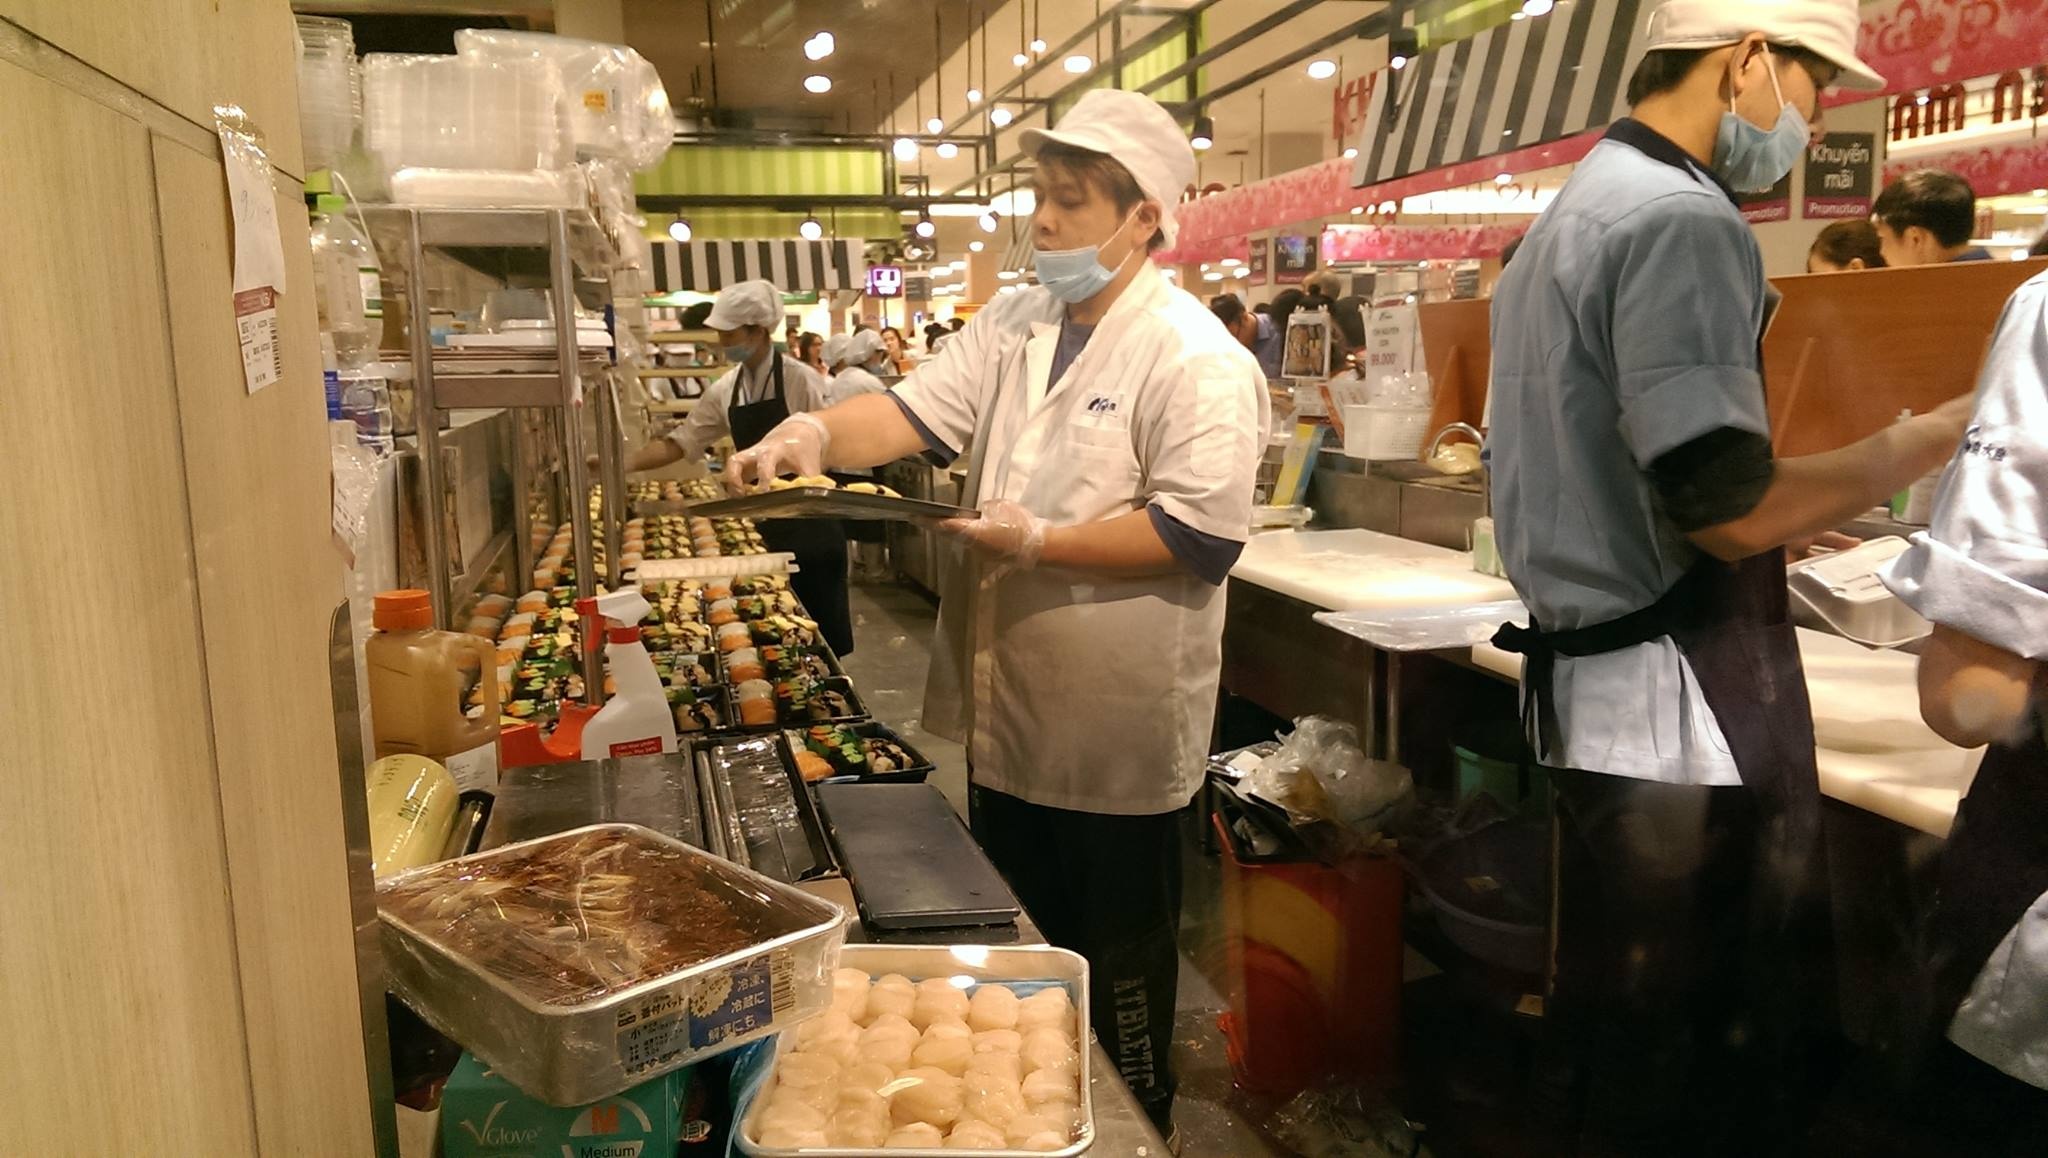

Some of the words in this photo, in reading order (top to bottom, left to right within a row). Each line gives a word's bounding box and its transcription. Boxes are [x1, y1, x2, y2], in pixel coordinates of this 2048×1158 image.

[1823, 169, 1854, 189] mãi
[1743, 205, 1785, 218] omotion
[1808, 202, 1867, 215] Promotion
[592, 1103, 619, 1133] M
[580, 1145, 635, 1158] Medium
